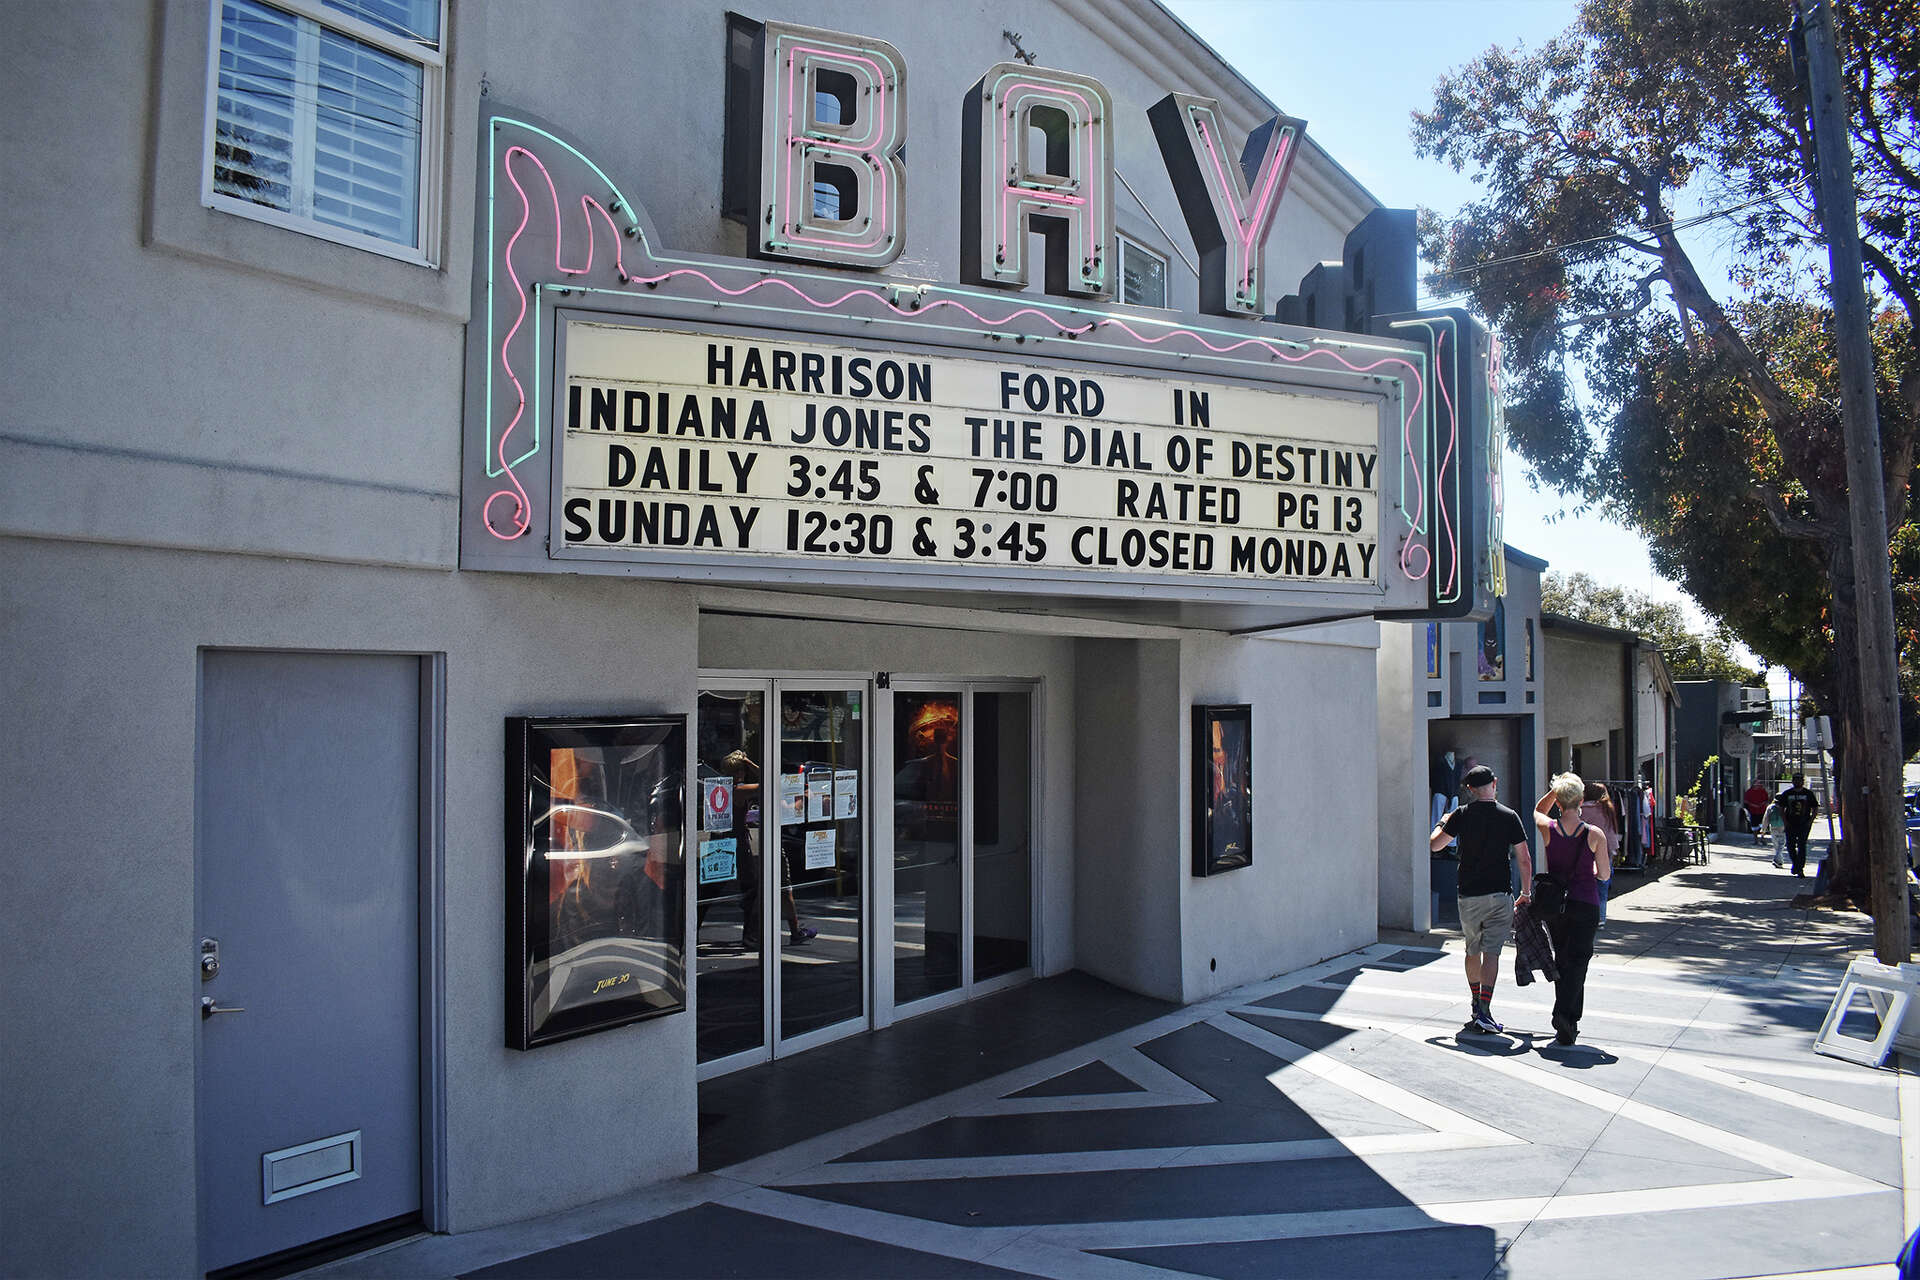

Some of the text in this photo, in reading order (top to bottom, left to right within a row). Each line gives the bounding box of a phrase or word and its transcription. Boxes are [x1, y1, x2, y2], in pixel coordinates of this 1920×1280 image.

[755, 18, 1306, 318] BAY
[707, 343, 1210, 429] HARRISON FORD IN
[568, 385, 1378, 489] INDIANA JONES THE DIAL OF DESTINY
[608, 444, 758, 494] DAILY
[787, 454, 881, 502] 3:45
[914, 464, 940, 506] &
[972, 467, 1058, 513] 7:00
[1116, 478, 1241, 525] RATED
[563, 497, 1377, 579] SUNDAY 12:30 & 3:45 CLOSED MONDAY
[593, 975, 617, 994] JUNE
